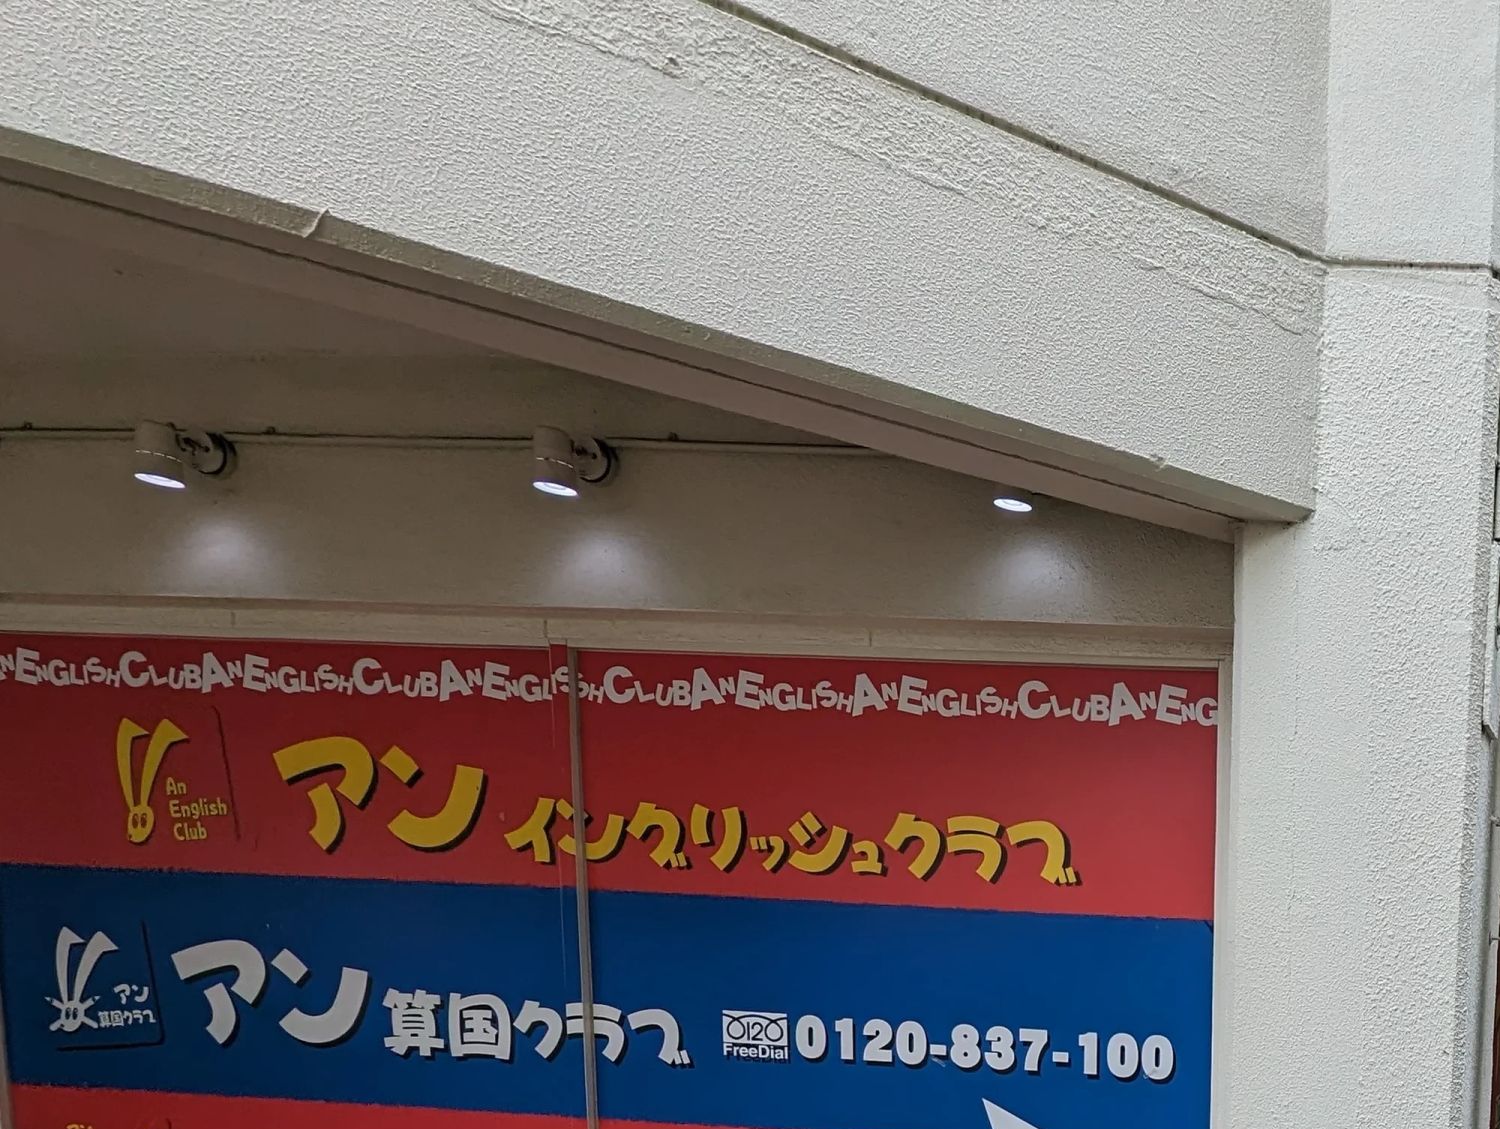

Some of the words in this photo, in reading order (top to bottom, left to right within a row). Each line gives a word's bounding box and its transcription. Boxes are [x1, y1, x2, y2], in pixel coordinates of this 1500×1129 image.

[166, 776, 187, 795] An
[169, 797, 227, 818] English
[173, 822, 208, 841] Club
[113, 983, 149, 1005] アン
[723, 1042, 789, 1060] FreeDial
[795, 1014, 1174, 1081] 0120-837-100
